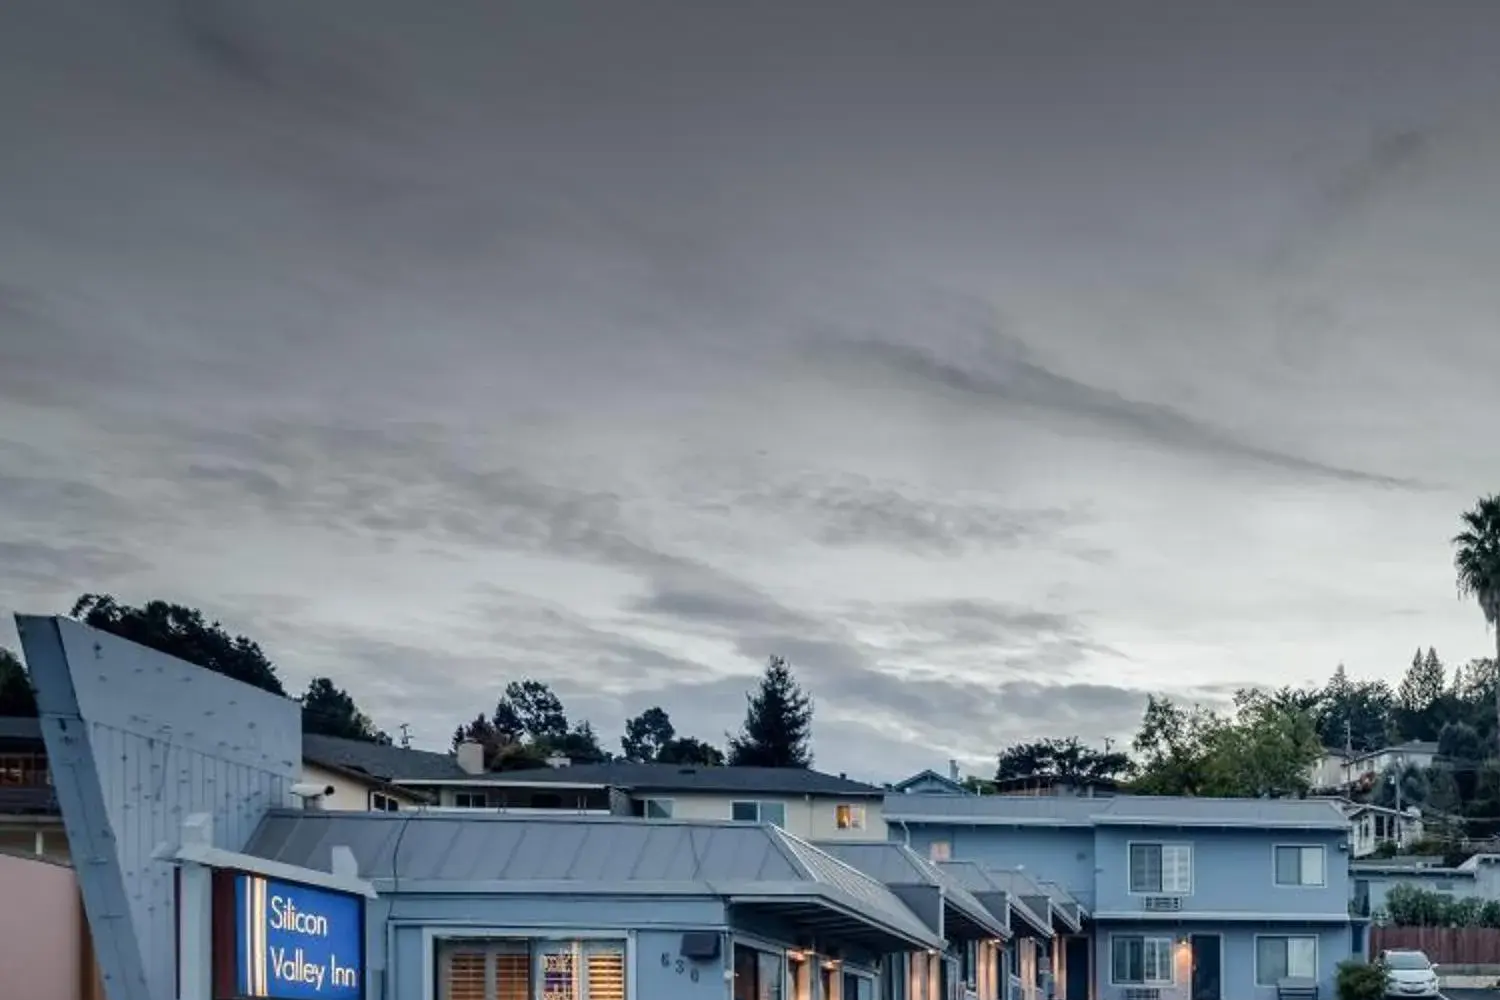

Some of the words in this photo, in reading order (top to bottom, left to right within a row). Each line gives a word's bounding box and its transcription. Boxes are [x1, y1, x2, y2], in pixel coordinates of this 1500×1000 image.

[270, 895, 328, 937] Silicon
[270, 946, 326, 991] Valley
[331, 954, 357, 988] Inn
